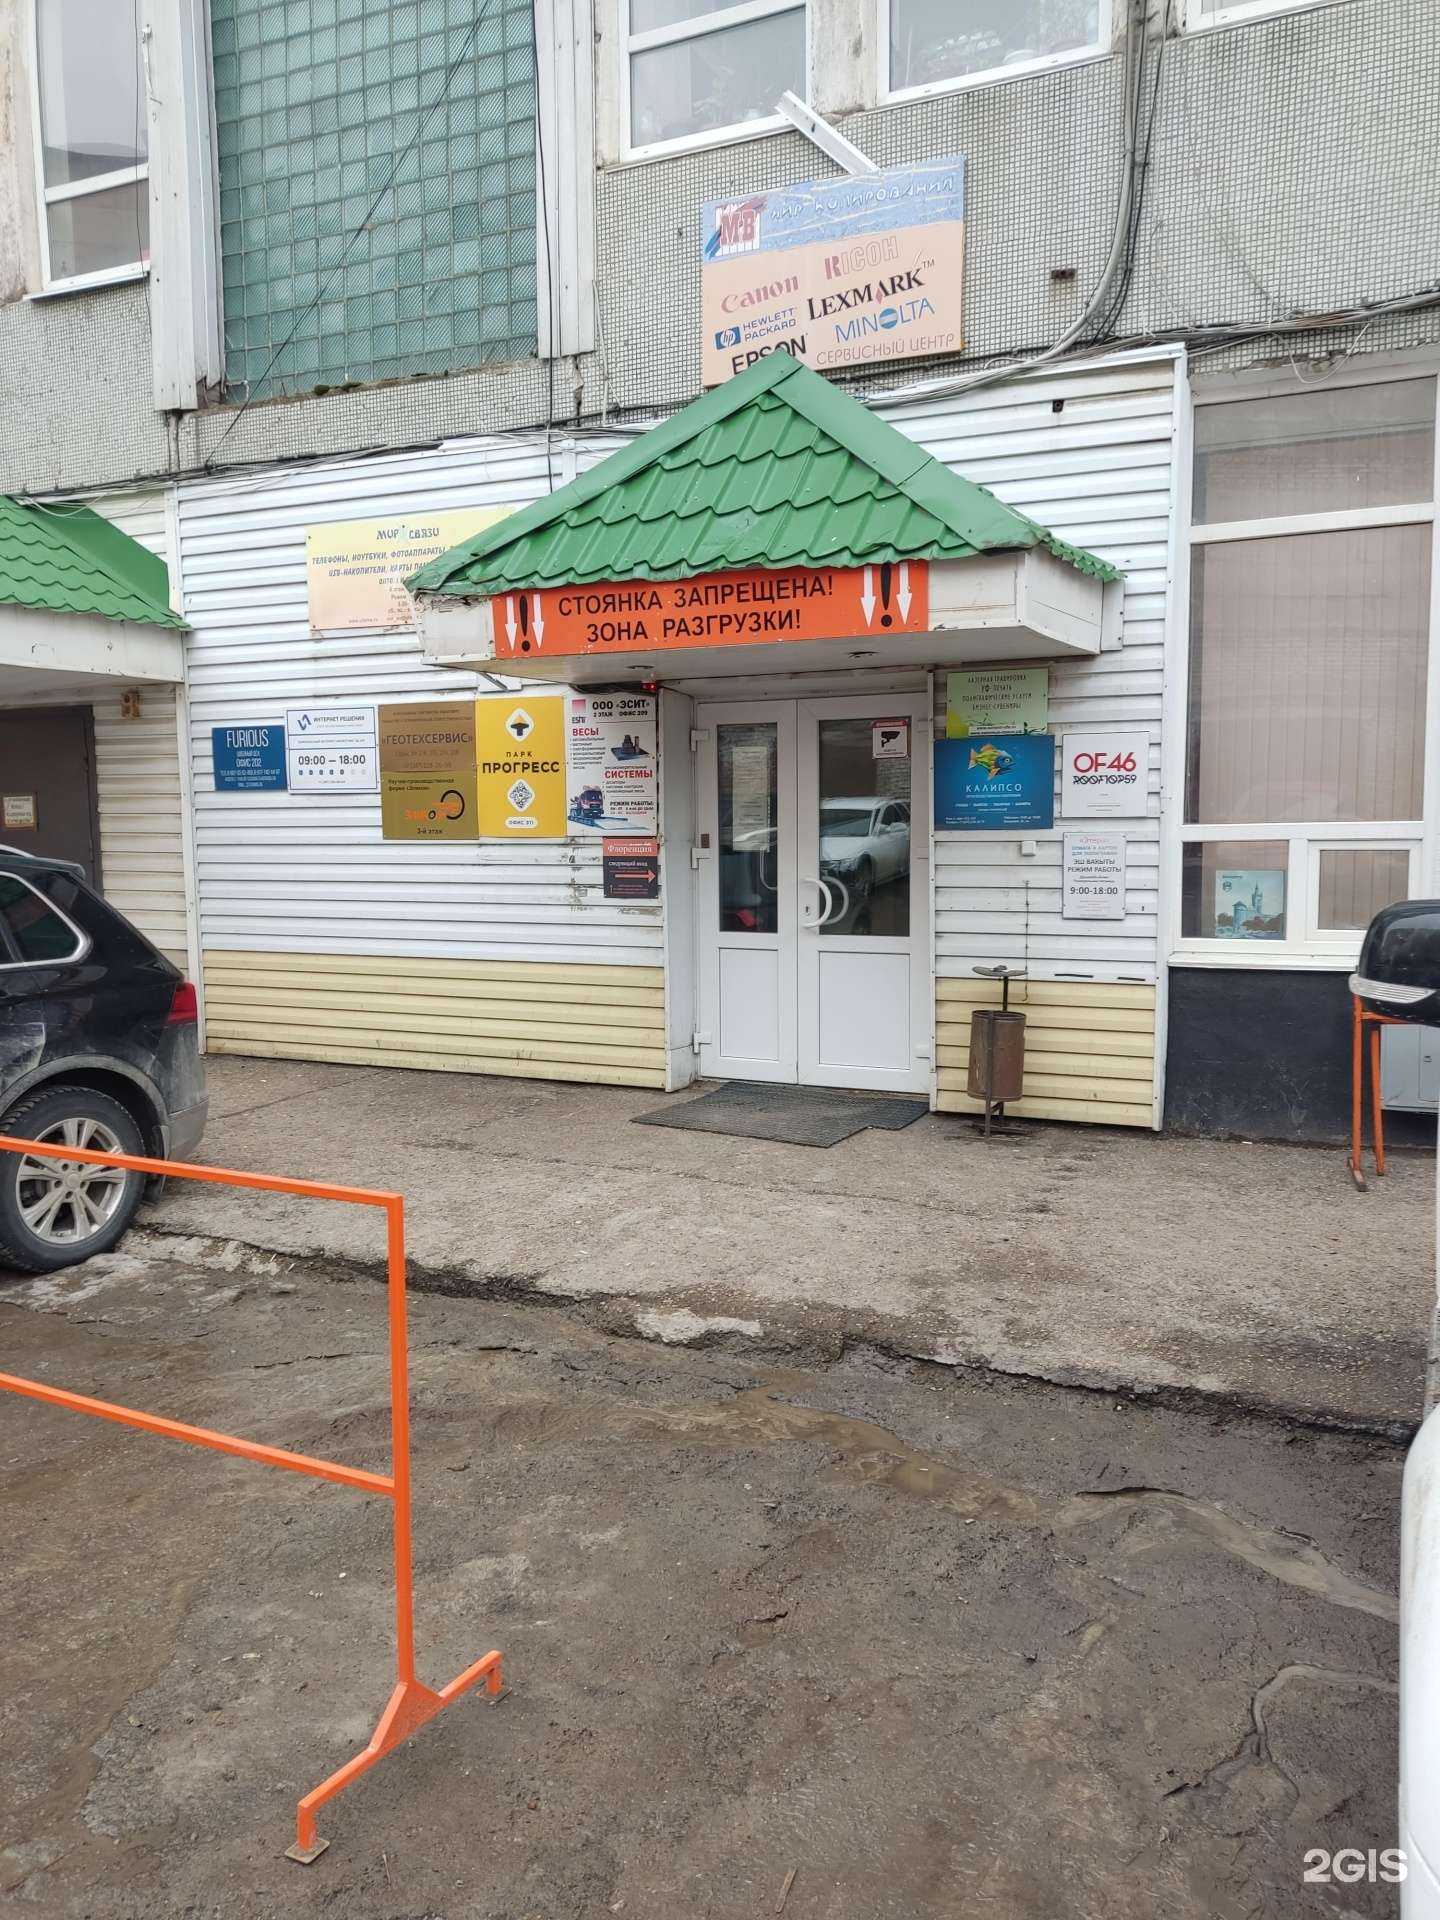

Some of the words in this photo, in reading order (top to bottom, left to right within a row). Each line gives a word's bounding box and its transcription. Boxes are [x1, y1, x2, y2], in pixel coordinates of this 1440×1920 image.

[824, 236, 900, 280] RICOH
[720, 275, 800, 314] Canon
[742, 307, 796, 331] HEWLETT
[834, 297, 935, 343] MINOLTA
[744, 317, 797, 342] PACKARD
[816, 337, 905, 366] СЕРВИСНЫЙ
[909, 332, 955, 353] ЦЕНТР
[376, 528, 399, 541] МИР
[408, 527, 440, 540] СВЯЗИ
[389, 563, 412, 574] КАРТЫ
[558, 590, 663, 617] СТОЯНКА
[673, 575, 833, 609] ЗАПРЕЩЕНА!
[586, 620, 649, 643] ЗОНА
[662, 609, 801, 638] РАЗГРУЗКИ!
[592, 700, 614, 711] ООО
[226, 729, 269, 748] FURIOUS
[572, 728, 599, 737] ВЕСЫ
[298, 755, 326, 766] 09:00
[338, 754, 367, 765] 18:00
[482, 761, 560, 774] ПРОГРЕСС
[604, 770, 654, 779] СИСТЕМЫ
[965, 783, 1022, 793] КАЛИПСО
[1070, 886, 1118, 895] 9:00-18:00
